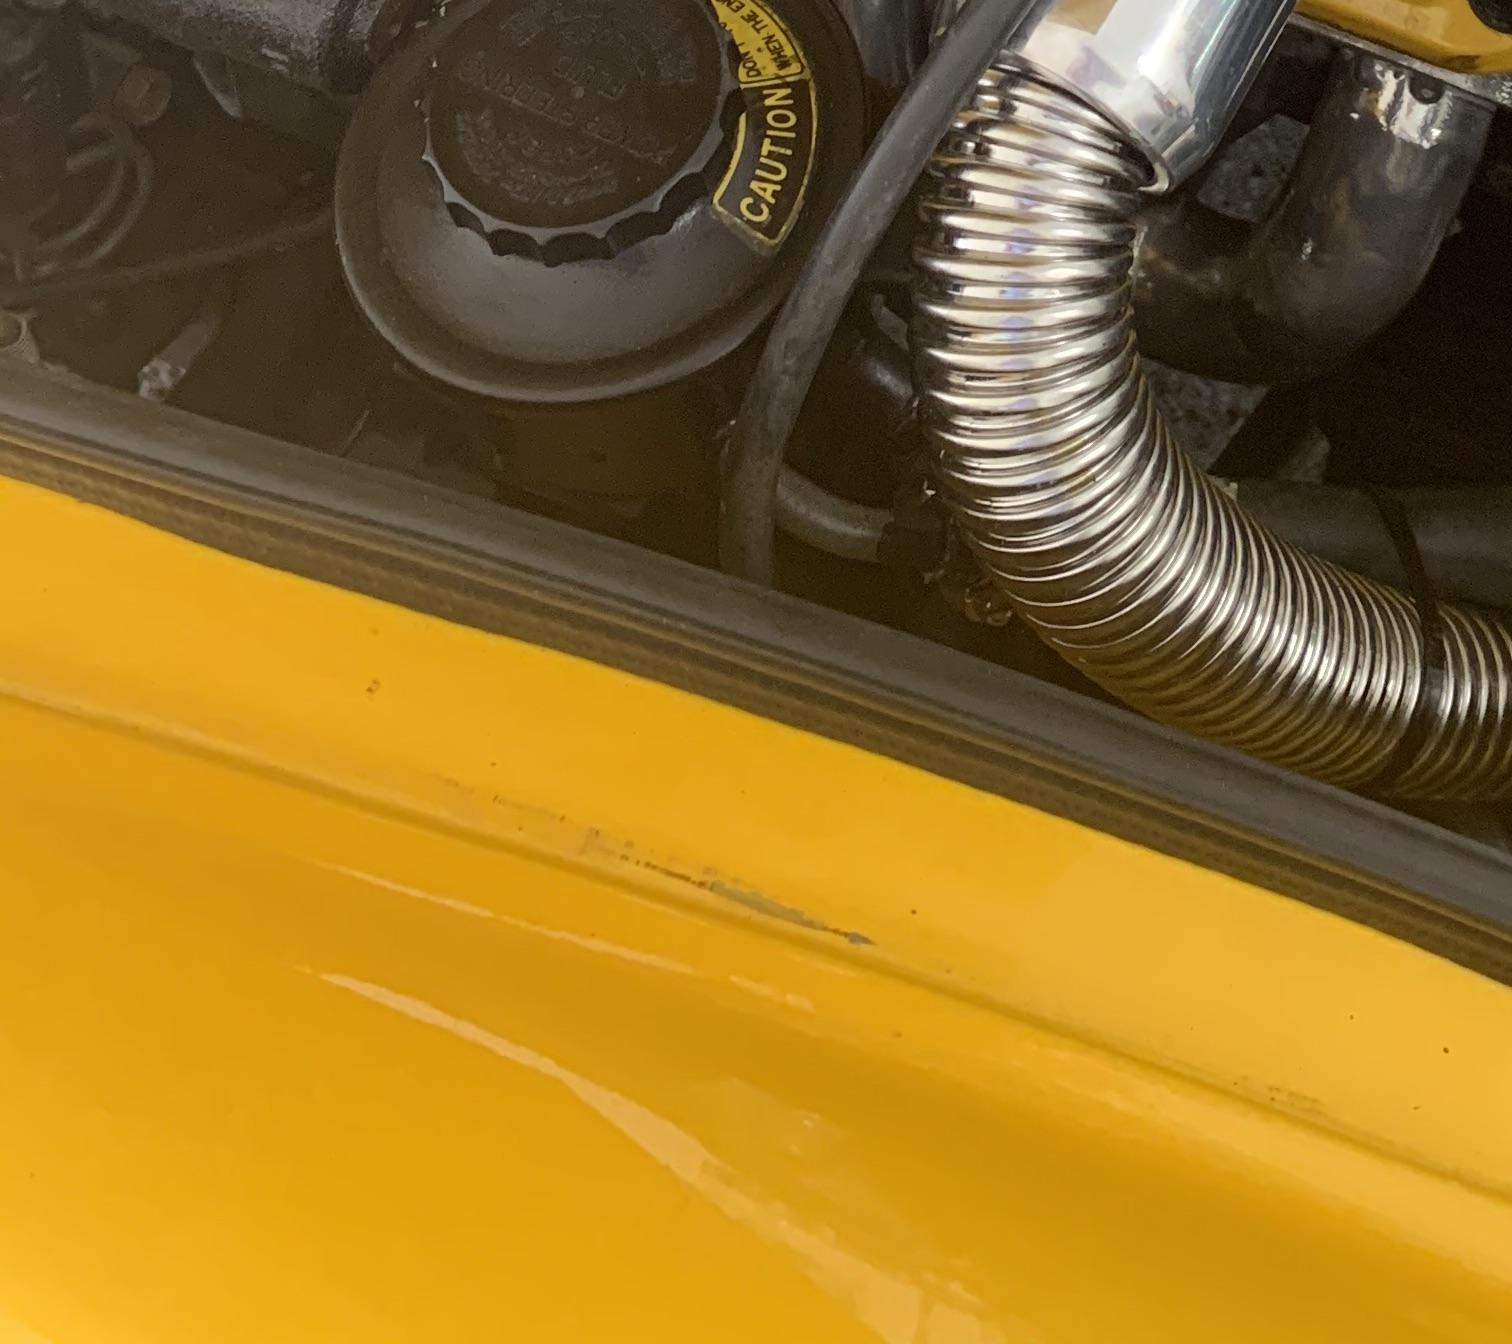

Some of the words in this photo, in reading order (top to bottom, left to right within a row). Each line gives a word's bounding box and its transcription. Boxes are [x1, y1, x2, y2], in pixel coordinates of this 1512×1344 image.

[740, 9, 768, 34] THE
[762, 33, 792, 71] WHEN
[739, 87, 797, 223] CAUTION
